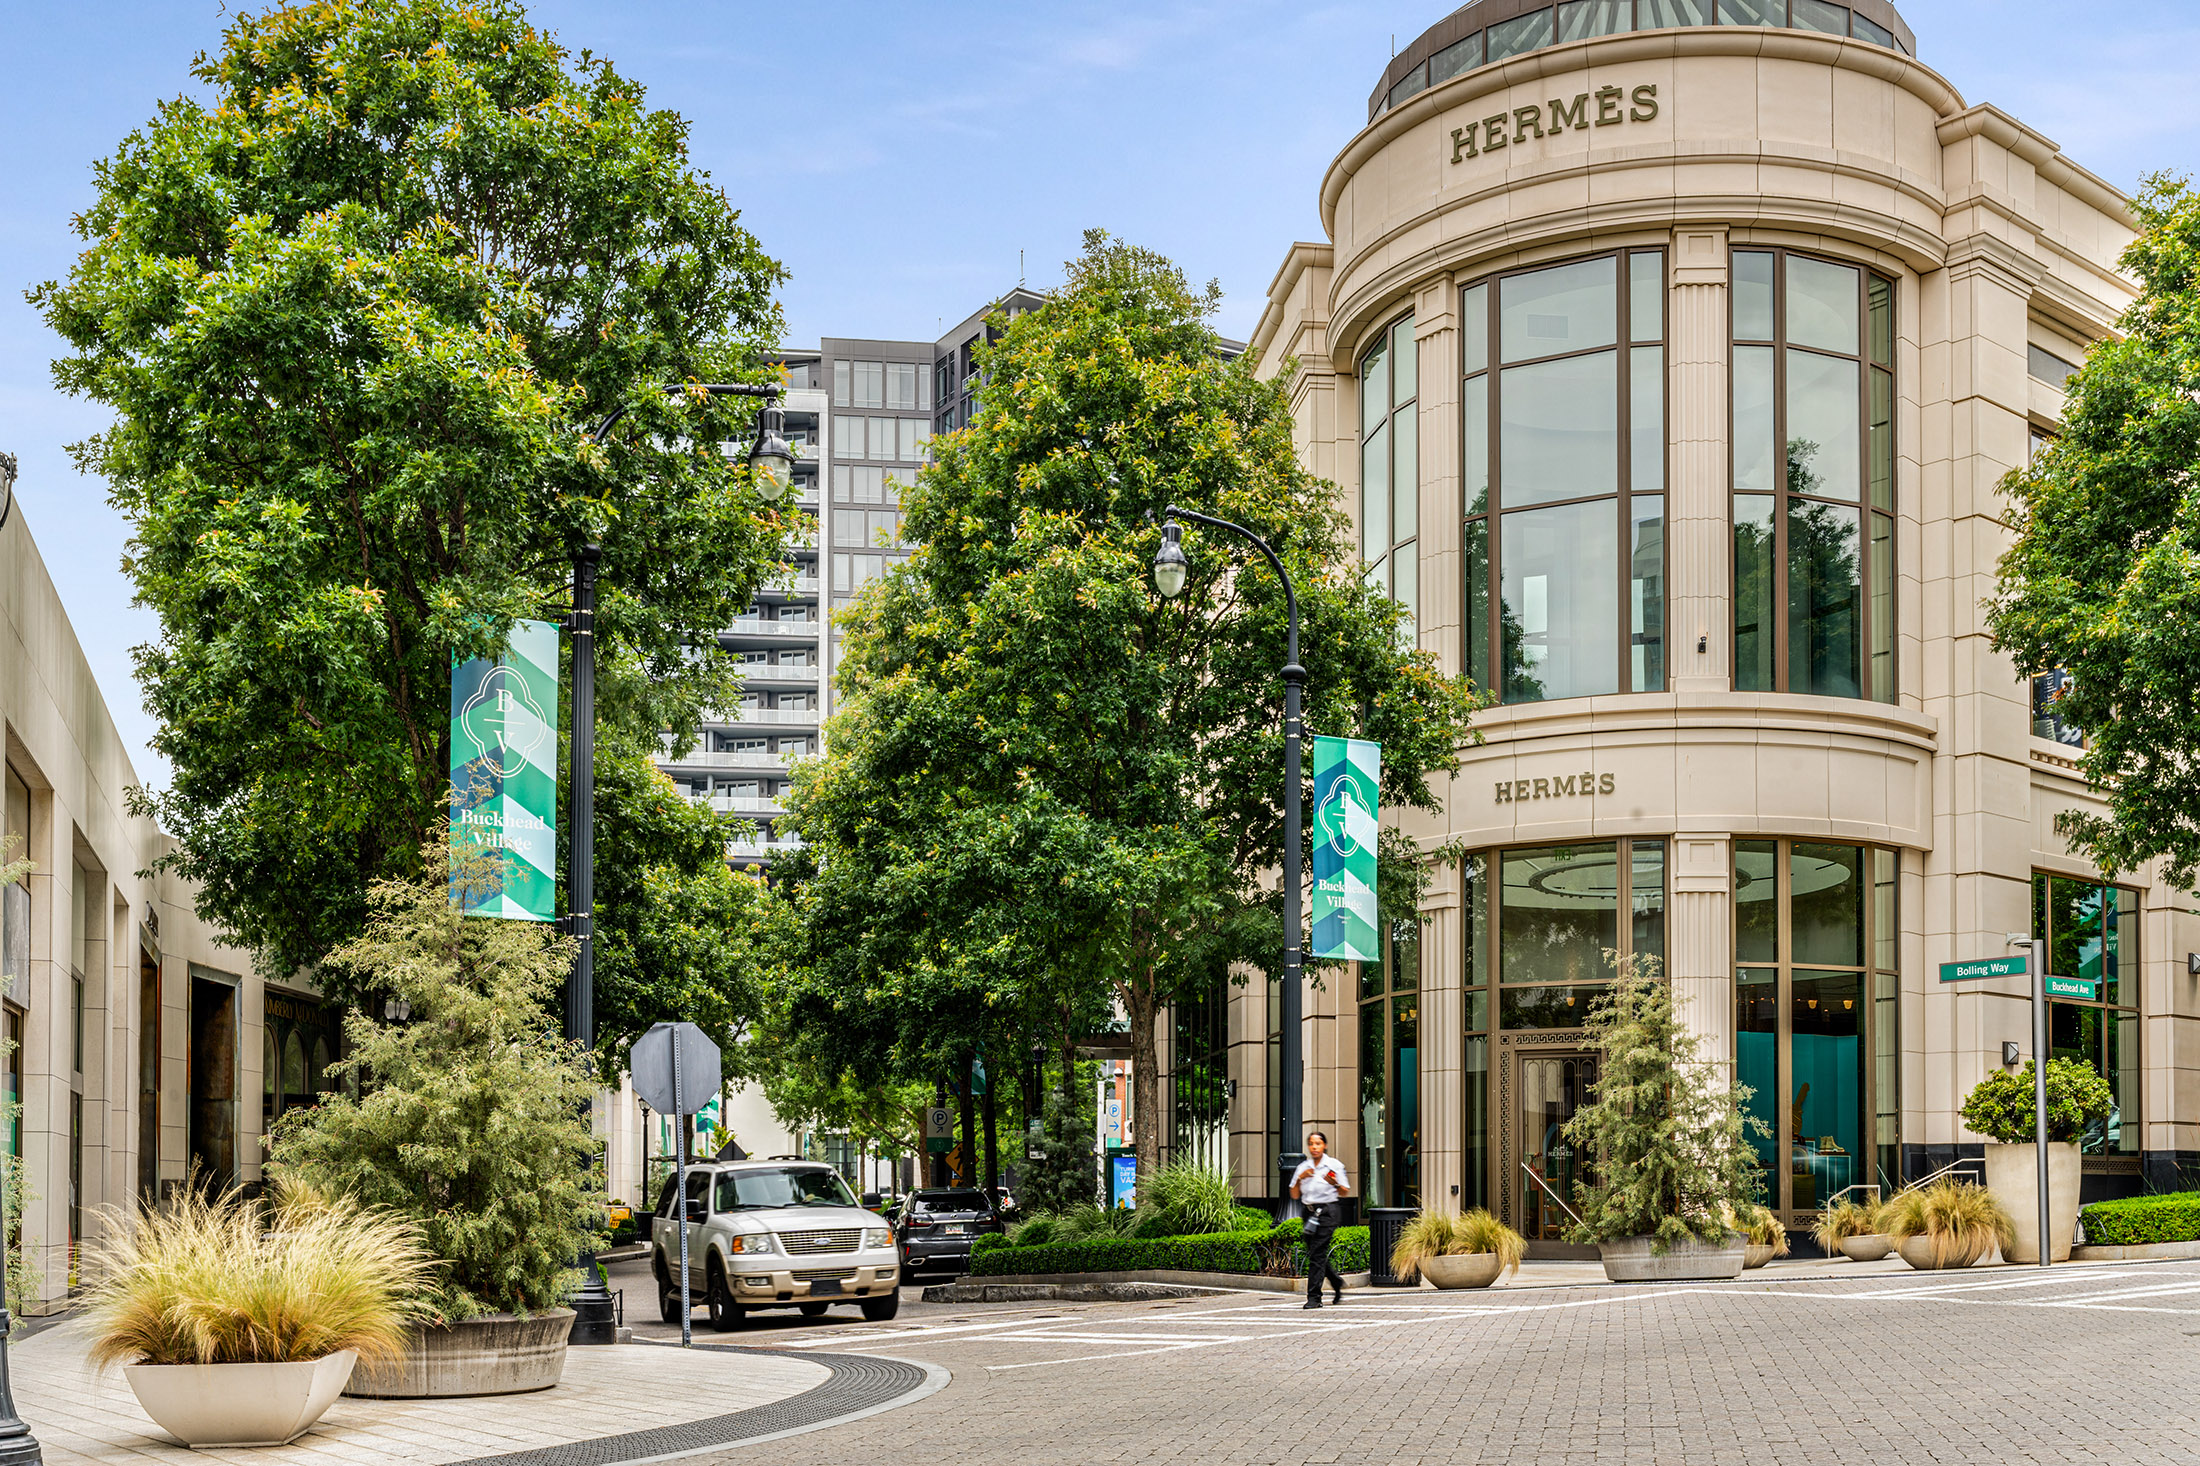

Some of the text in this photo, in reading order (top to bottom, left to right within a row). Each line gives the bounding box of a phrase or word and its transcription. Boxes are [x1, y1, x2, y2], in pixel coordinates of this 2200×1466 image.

[1450, 84, 1659, 165] HERMÈS
[495, 688, 514, 713] B
[493, 729, 515, 755] V
[1494, 771, 1616, 804] HERMÈS
[1340, 791, 1352, 809] B
[460, 808, 545, 830] Buckhead
[1338, 821, 1352, 840] V
[1318, 878, 1370, 894] Buckhead
[1326, 895, 1363, 911] Village
[1957, 963, 2009, 976] Bolling Way
[2052, 981, 2089, 994] Buckhead Ave
